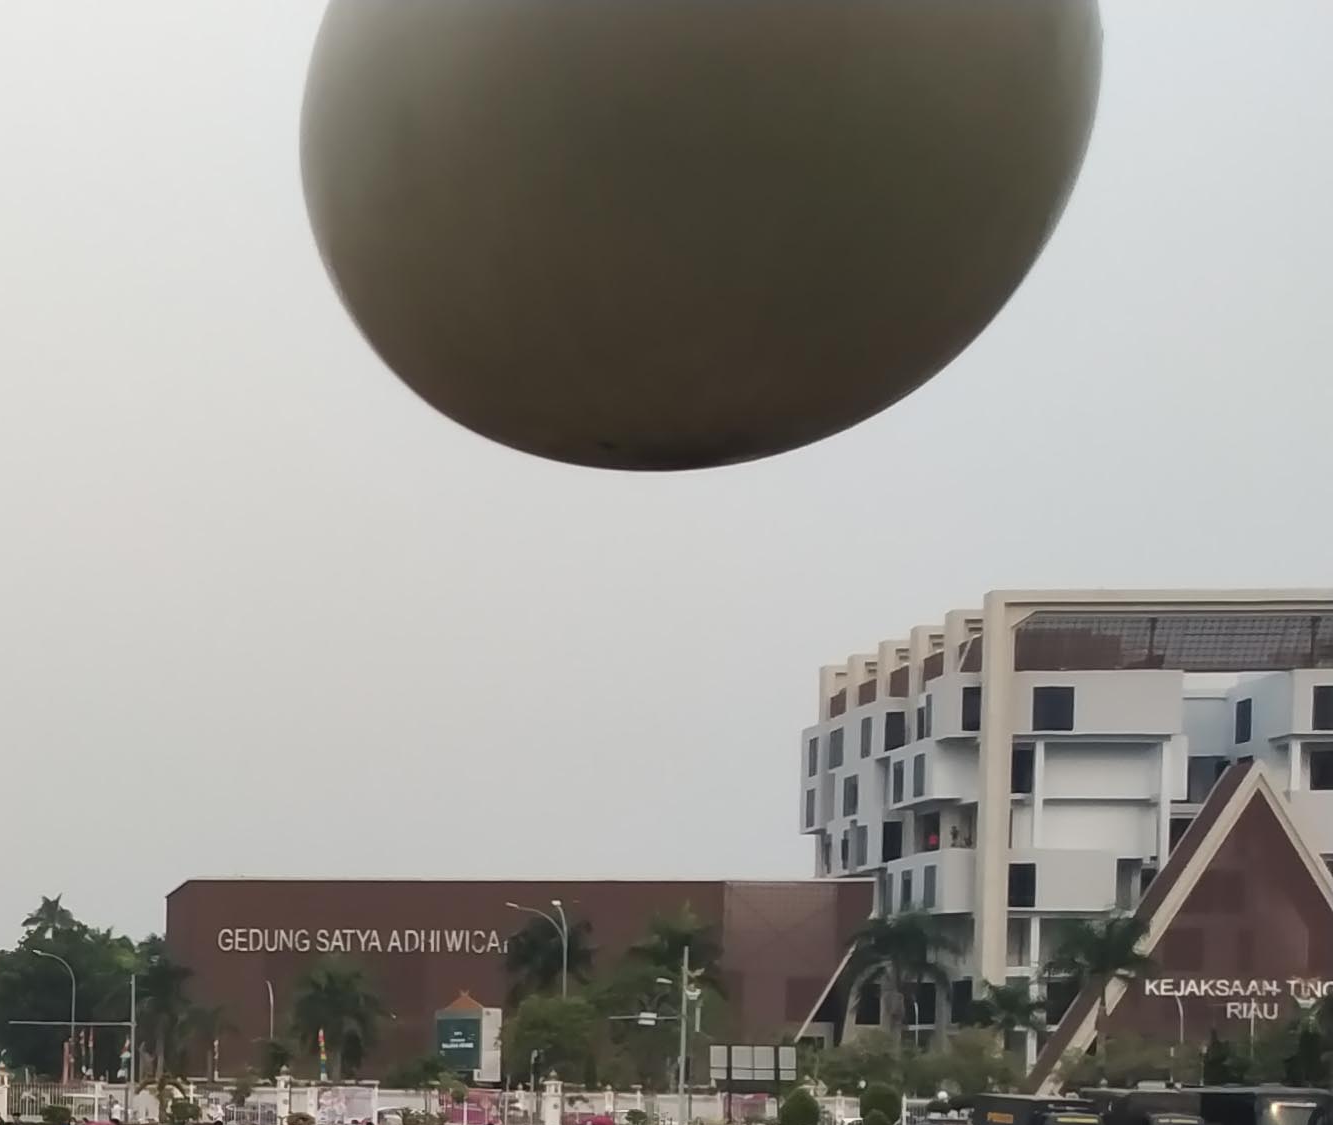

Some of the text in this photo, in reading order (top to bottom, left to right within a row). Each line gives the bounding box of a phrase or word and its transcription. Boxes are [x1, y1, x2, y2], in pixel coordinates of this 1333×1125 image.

[217, 928, 310, 952] GEDUNG
[315, 928, 382, 953] SATYA
[387, 929, 440, 953] ADHI
[1144, 978, 1278, 996] KEJAKSAAN
[1226, 1002, 1279, 1020] RIAU
